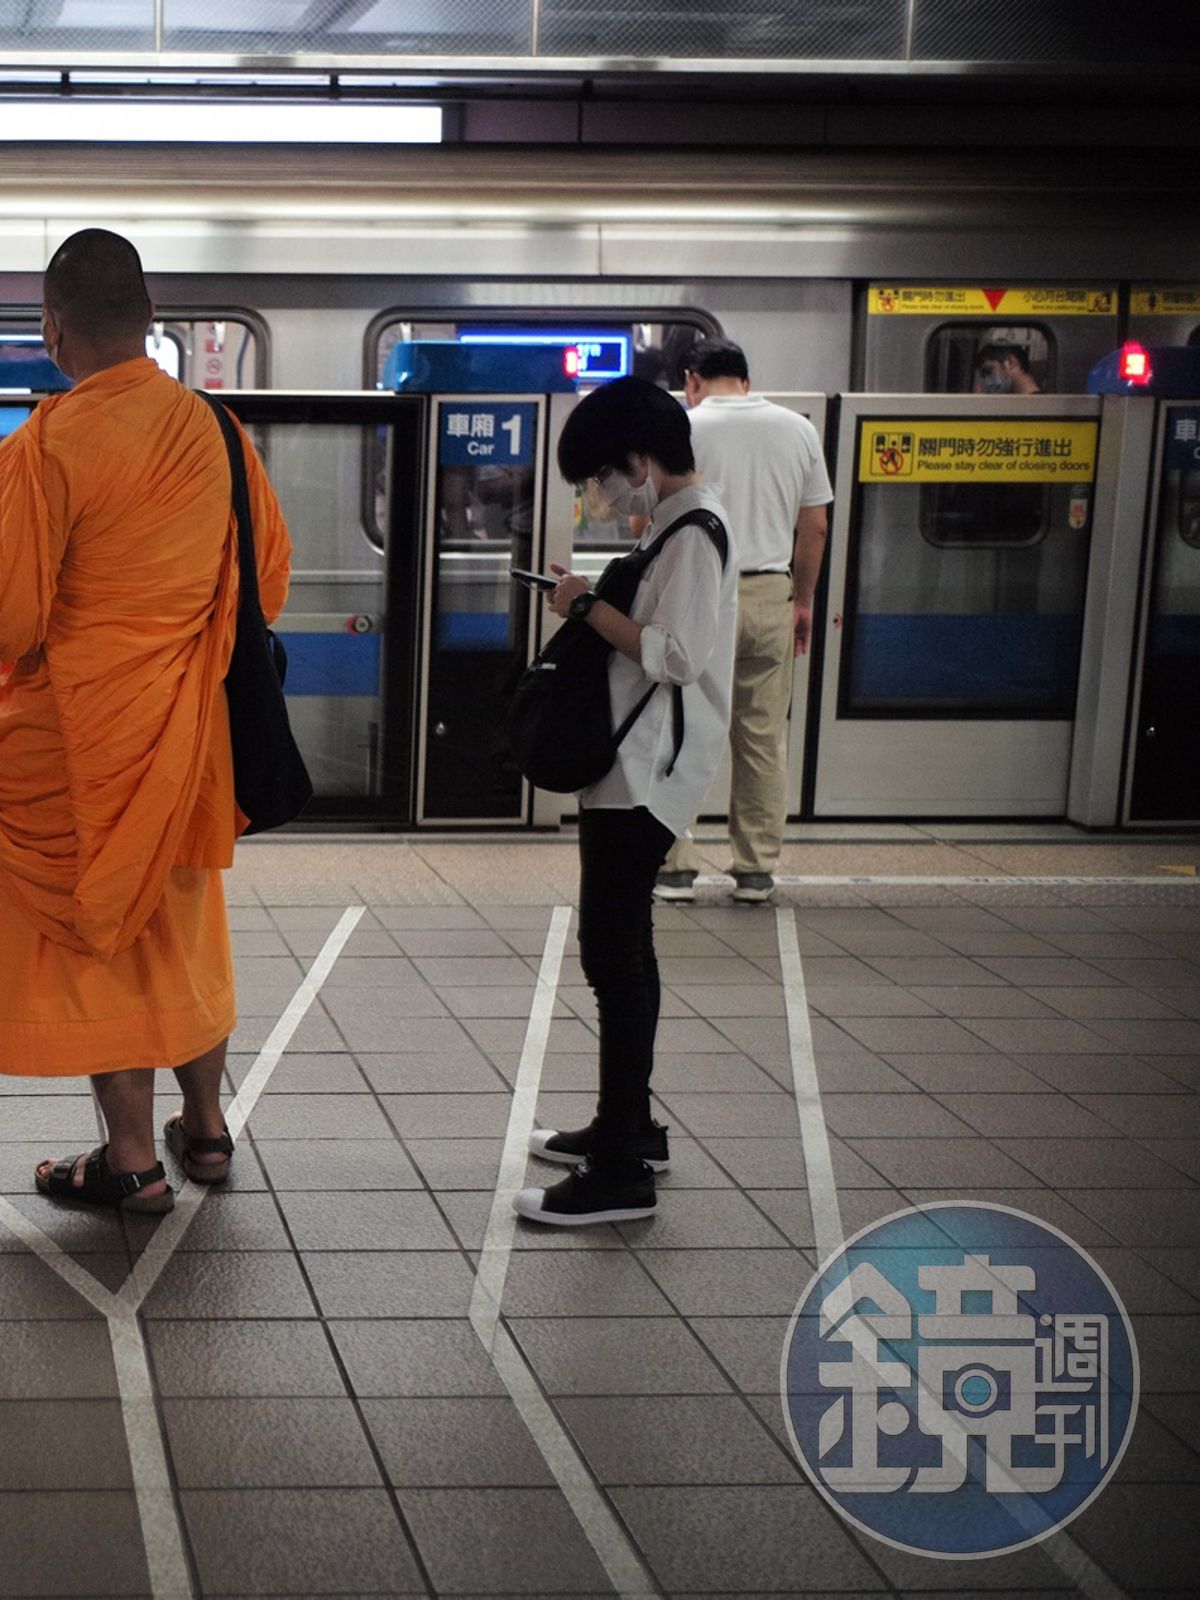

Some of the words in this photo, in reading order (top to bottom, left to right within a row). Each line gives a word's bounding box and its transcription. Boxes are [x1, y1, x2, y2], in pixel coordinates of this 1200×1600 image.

[446, 412, 495, 438] 車廂
[501, 414, 521, 456] 1
[1173, 418, 1200, 443] 車
[467, 441, 495, 456] Car
[917, 437, 1073, 458] 關門時勿強行進出
[917, 459, 952, 471] Please
[954, 460, 976, 472] stay
[978, 460, 1004, 471] clear
[1006, 460, 1017, 471] of
[1018, 459, 1057, 473] closing
[1059, 460, 1091, 471] doors
